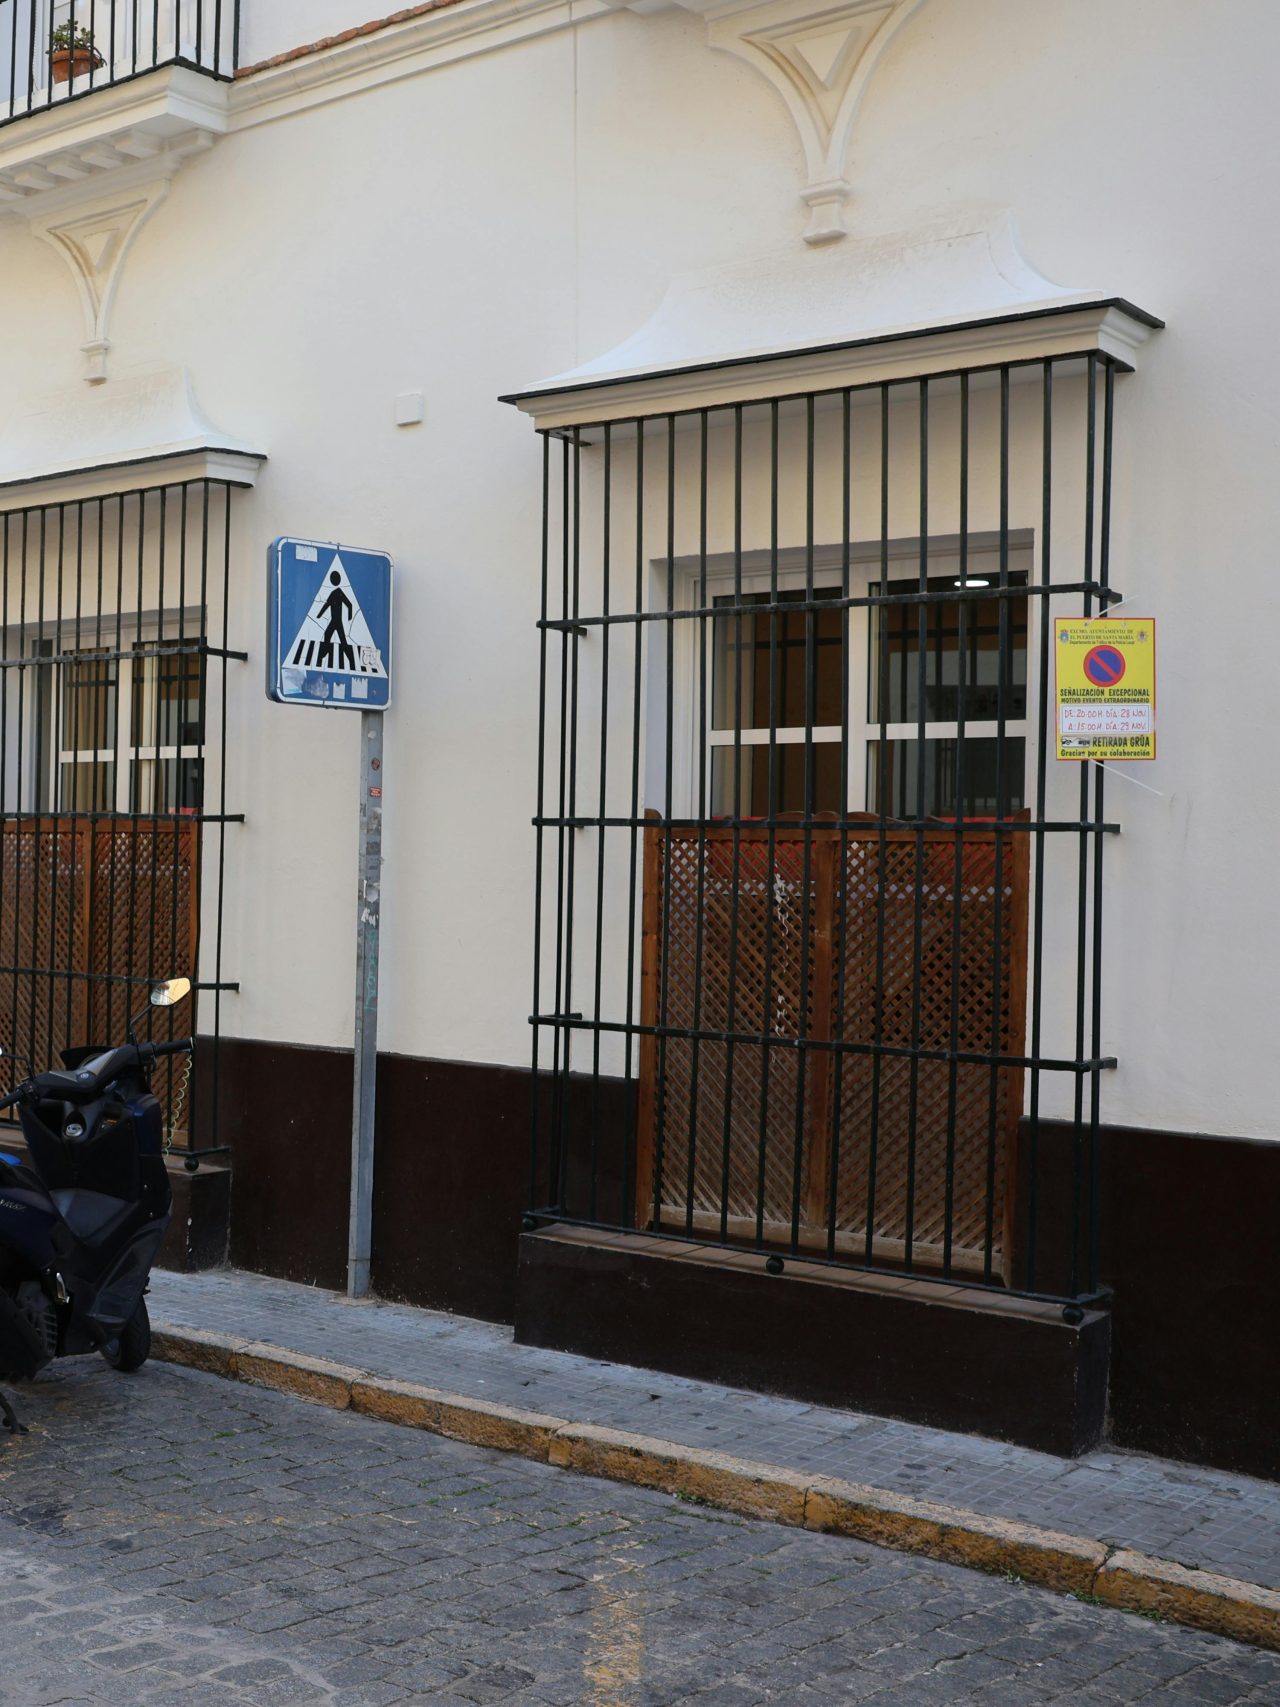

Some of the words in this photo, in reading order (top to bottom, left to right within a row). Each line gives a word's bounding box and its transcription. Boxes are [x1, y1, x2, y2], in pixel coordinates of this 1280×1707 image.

[1108, 688, 1150, 697] EXCEPCIONAL
[1093, 736, 1128, 747] RETIRADA
[1130, 734, 1150, 747] GRÚA
